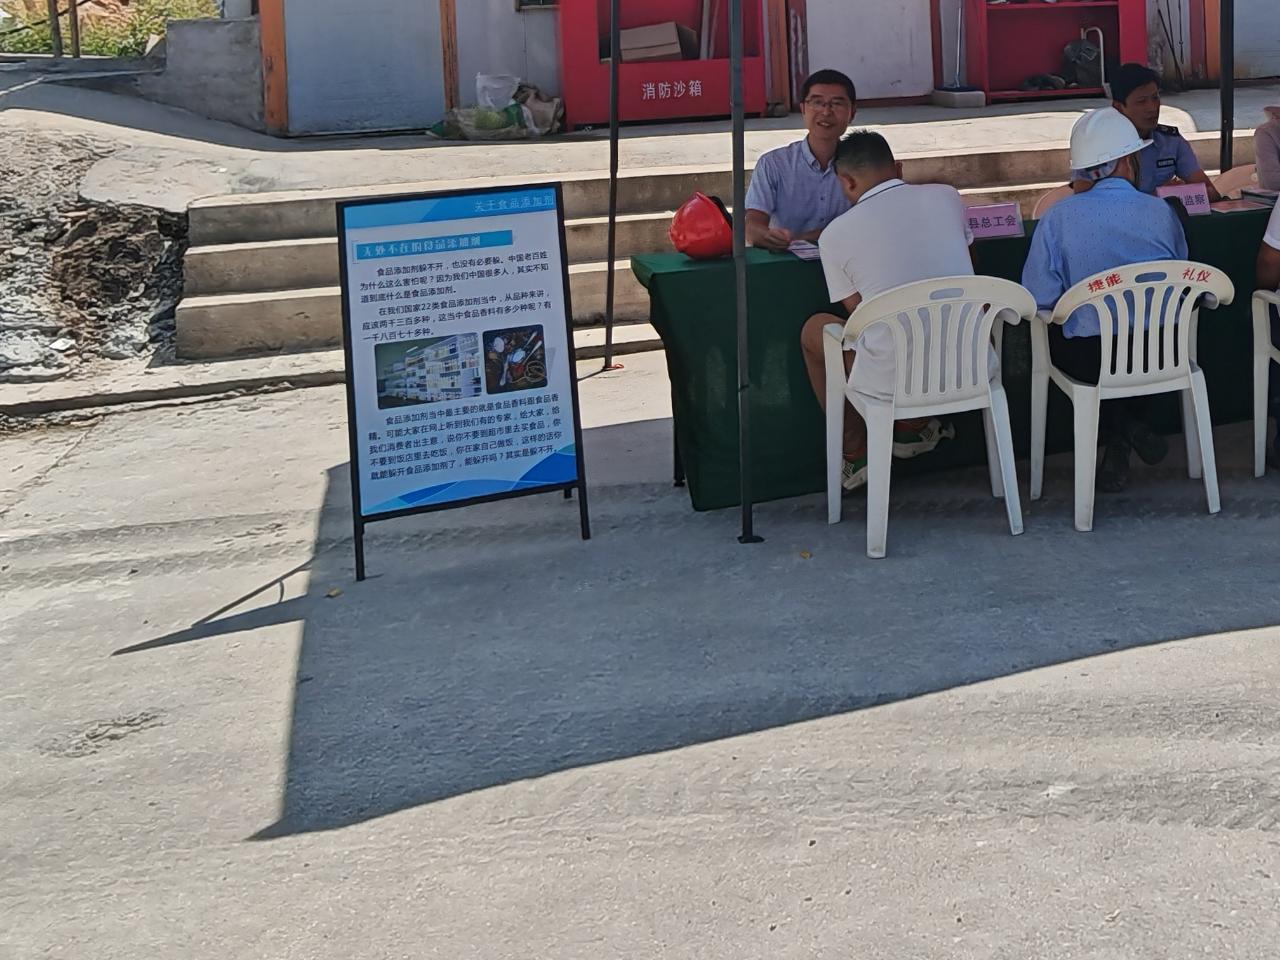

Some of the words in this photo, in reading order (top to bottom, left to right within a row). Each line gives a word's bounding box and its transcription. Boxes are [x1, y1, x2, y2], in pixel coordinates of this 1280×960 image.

[642, 80, 702, 100] 消防沙箱
[968, 214, 1017, 230] 县总工会
